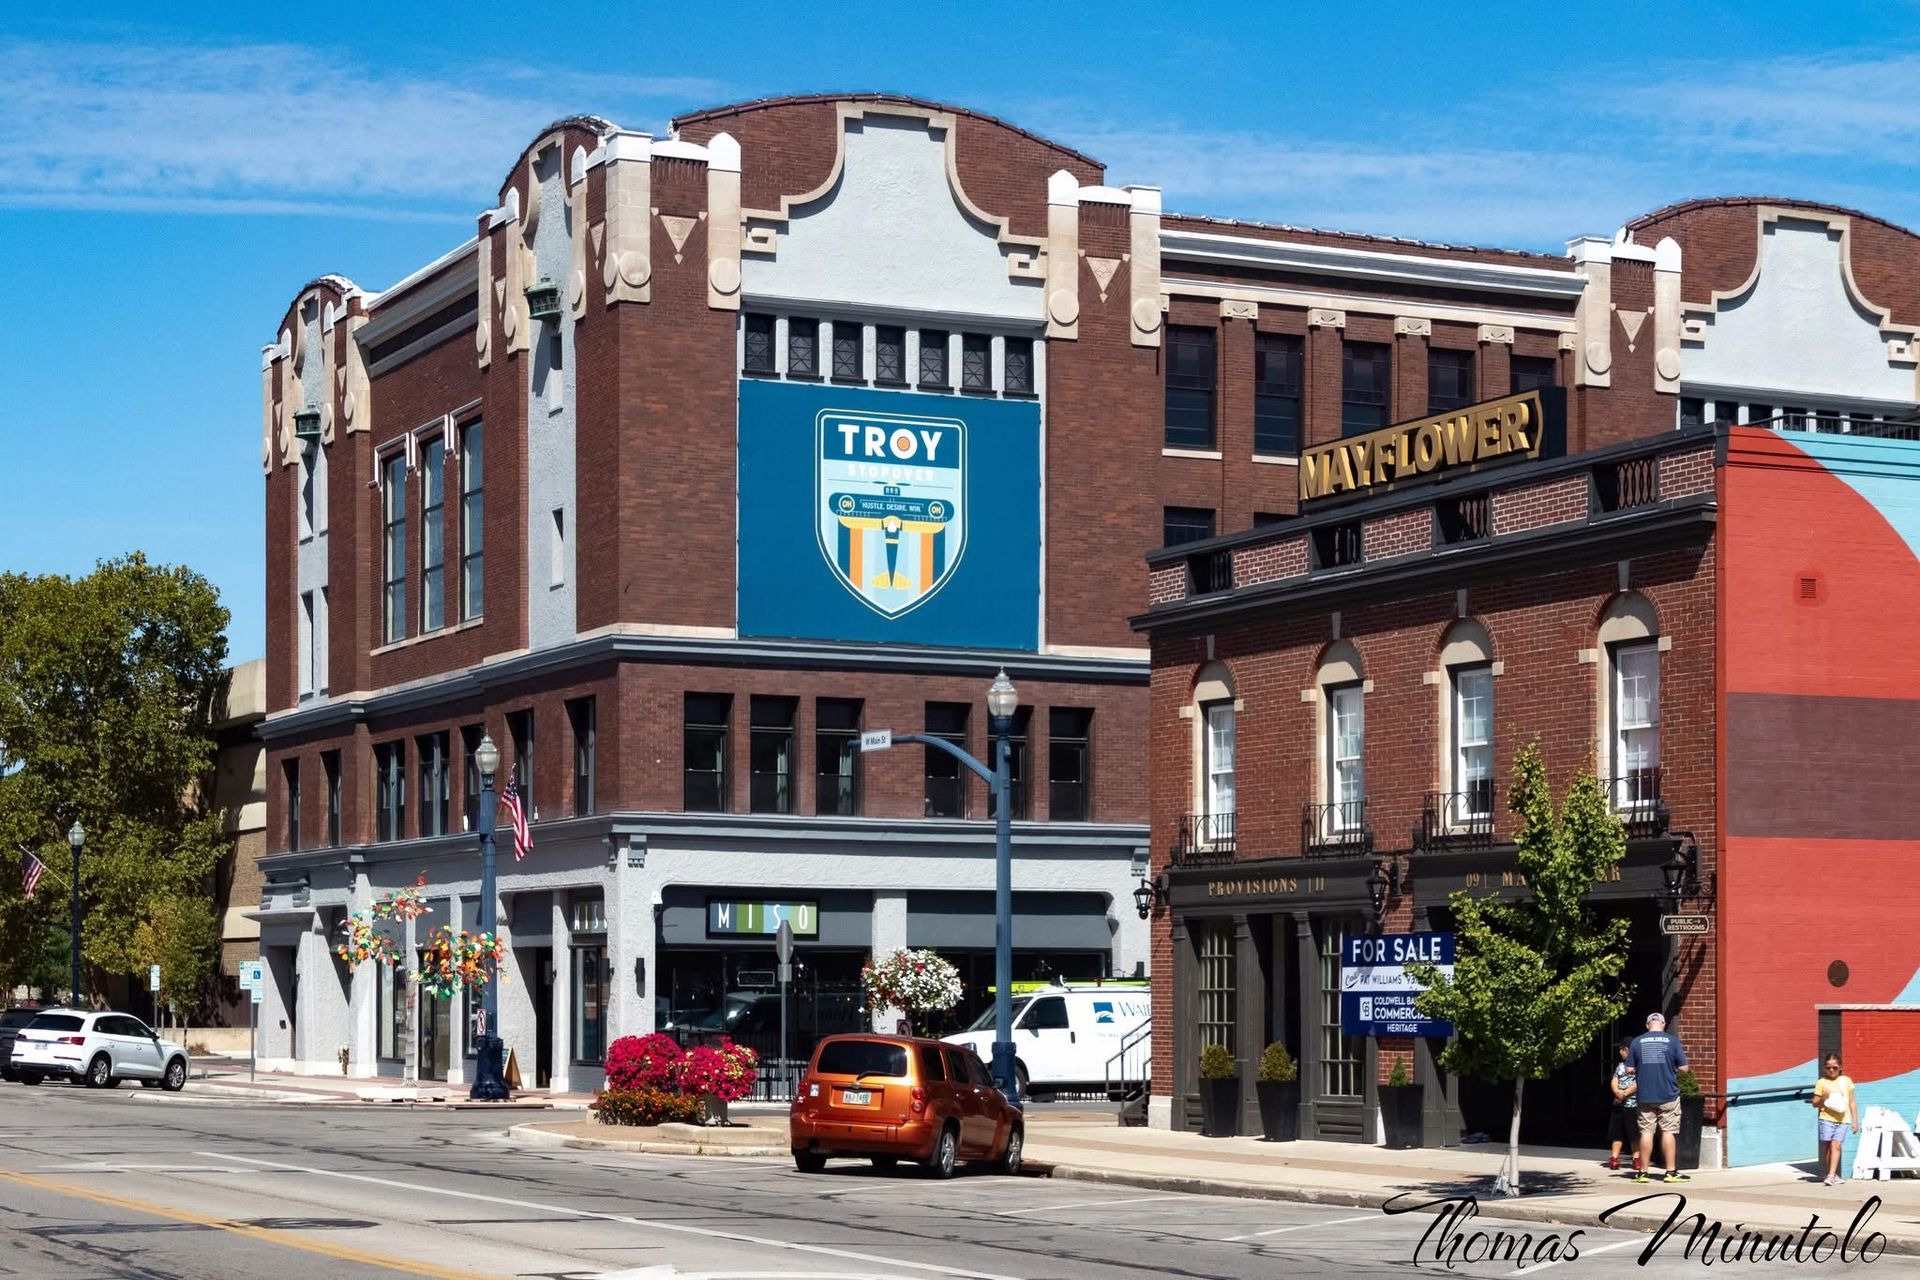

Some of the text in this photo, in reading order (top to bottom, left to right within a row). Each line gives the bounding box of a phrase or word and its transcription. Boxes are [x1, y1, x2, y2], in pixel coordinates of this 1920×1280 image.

[838, 423, 942, 461] TROY
[1300, 402, 1530, 500] MAYFLOWER
[847, 463, 934, 481] STOPOVER
[842, 500, 852, 508] OH
[931, 506, 941, 514] OH
[871, 736, 880, 745] Main
[1208, 877, 1297, 897] PROVISIONS
[718, 902, 808, 930] MISO
[1352, 937, 1441, 962] FOR SALE
[1372, 974, 1402, 985] WILLIAMS
[1374, 996, 1406, 1005] COLDWELL
[1387, 1023, 1418, 1033] HERITAGE
